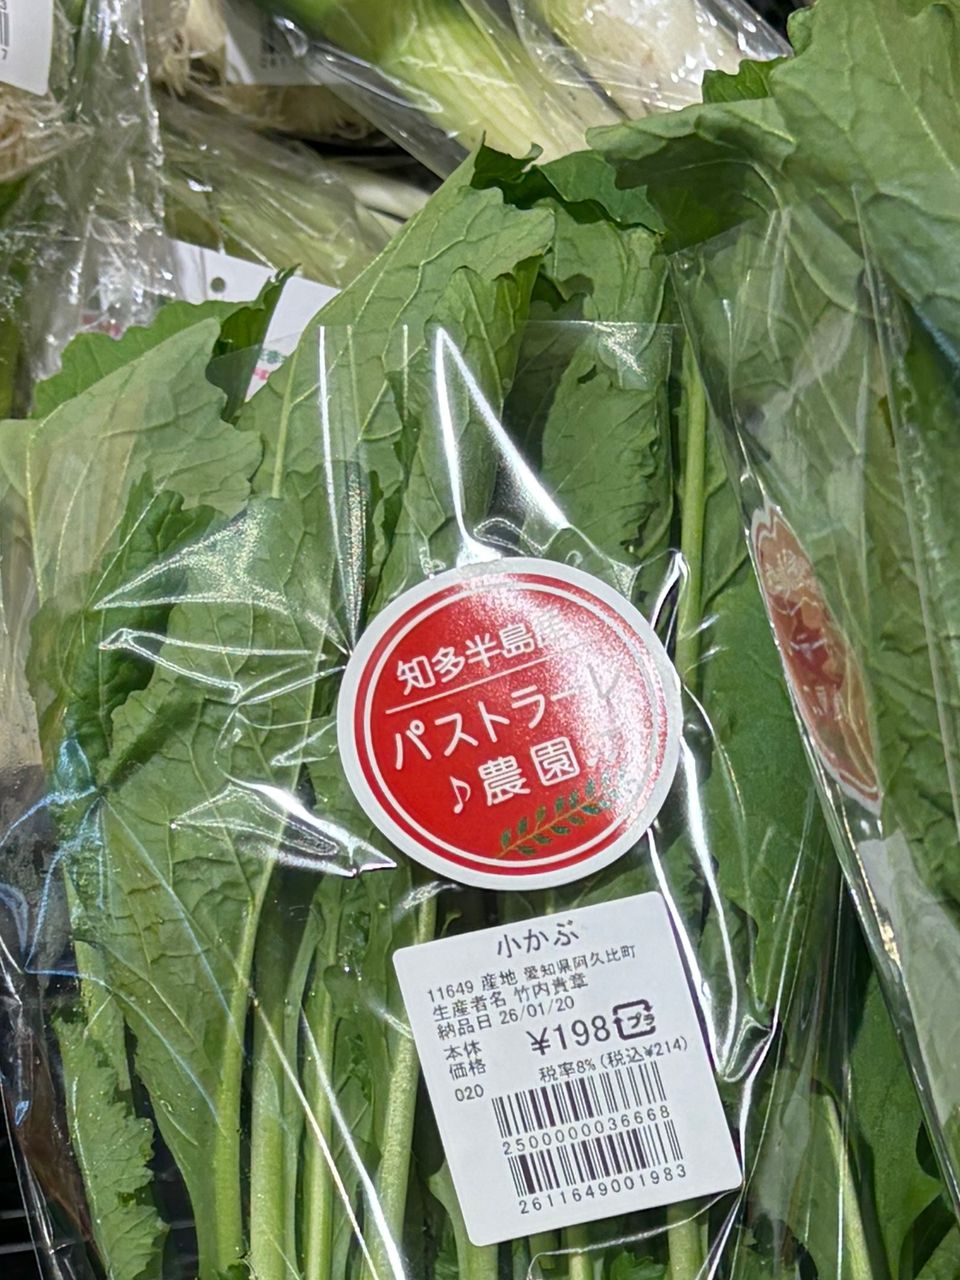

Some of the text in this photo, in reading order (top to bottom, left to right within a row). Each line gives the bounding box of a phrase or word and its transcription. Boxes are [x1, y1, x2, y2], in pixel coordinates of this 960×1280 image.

[497, 919, 579, 958] 小かぶ
[427, 945, 636, 1003] 11649 産地 愛知県阿久比町
[433, 992, 507, 1022] 生産者名
[437, 996, 575, 1041] 納品日 26/01/20
[627, 1012, 655, 1029] プラ
[444, 1040, 482, 1062] 本体
[526, 1015, 611, 1056] ¥198
[449, 1056, 487, 1080] 価格
[455, 1084, 485, 1103] 020
[503, 1105, 671, 1155] 2500000036668
[519, 1164, 687, 1214] 2611649001983
